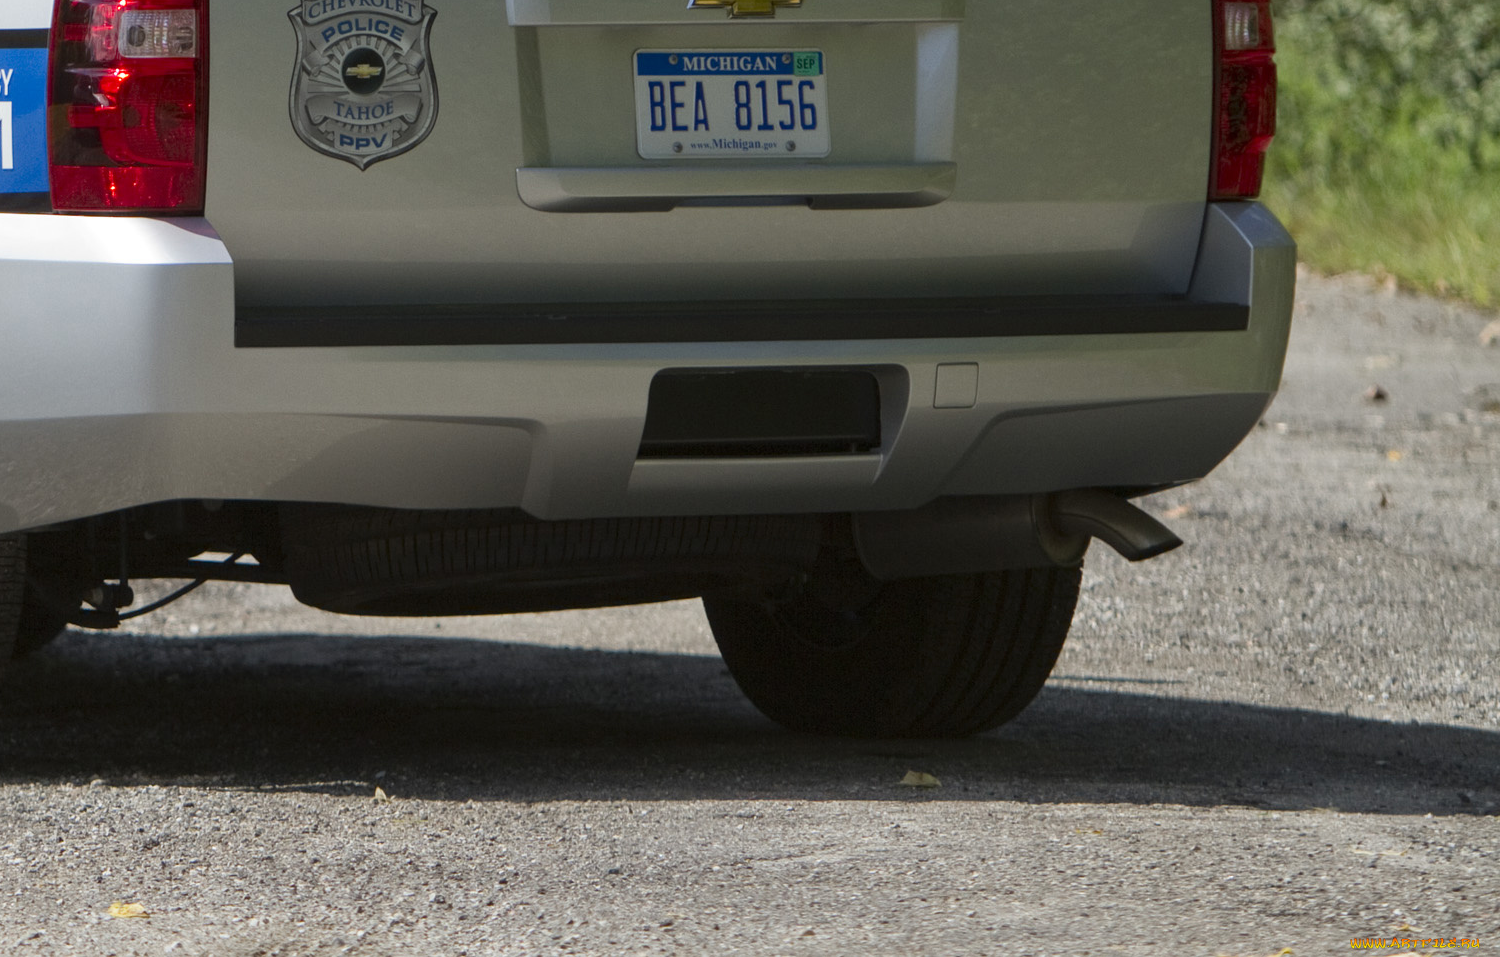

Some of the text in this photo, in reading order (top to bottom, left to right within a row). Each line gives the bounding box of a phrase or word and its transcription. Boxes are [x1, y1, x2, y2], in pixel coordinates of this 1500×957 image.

[321, 18, 405, 43] POLICE
[682, 56, 777, 72] MICHIGAN
[796, 58, 815, 70] SEP
[333, 100, 394, 120] TAHOE
[648, 80, 818, 132] BEA 8156
[339, 132, 388, 150] PPV
[690, 138, 778, 151] www.Michigan.gov
